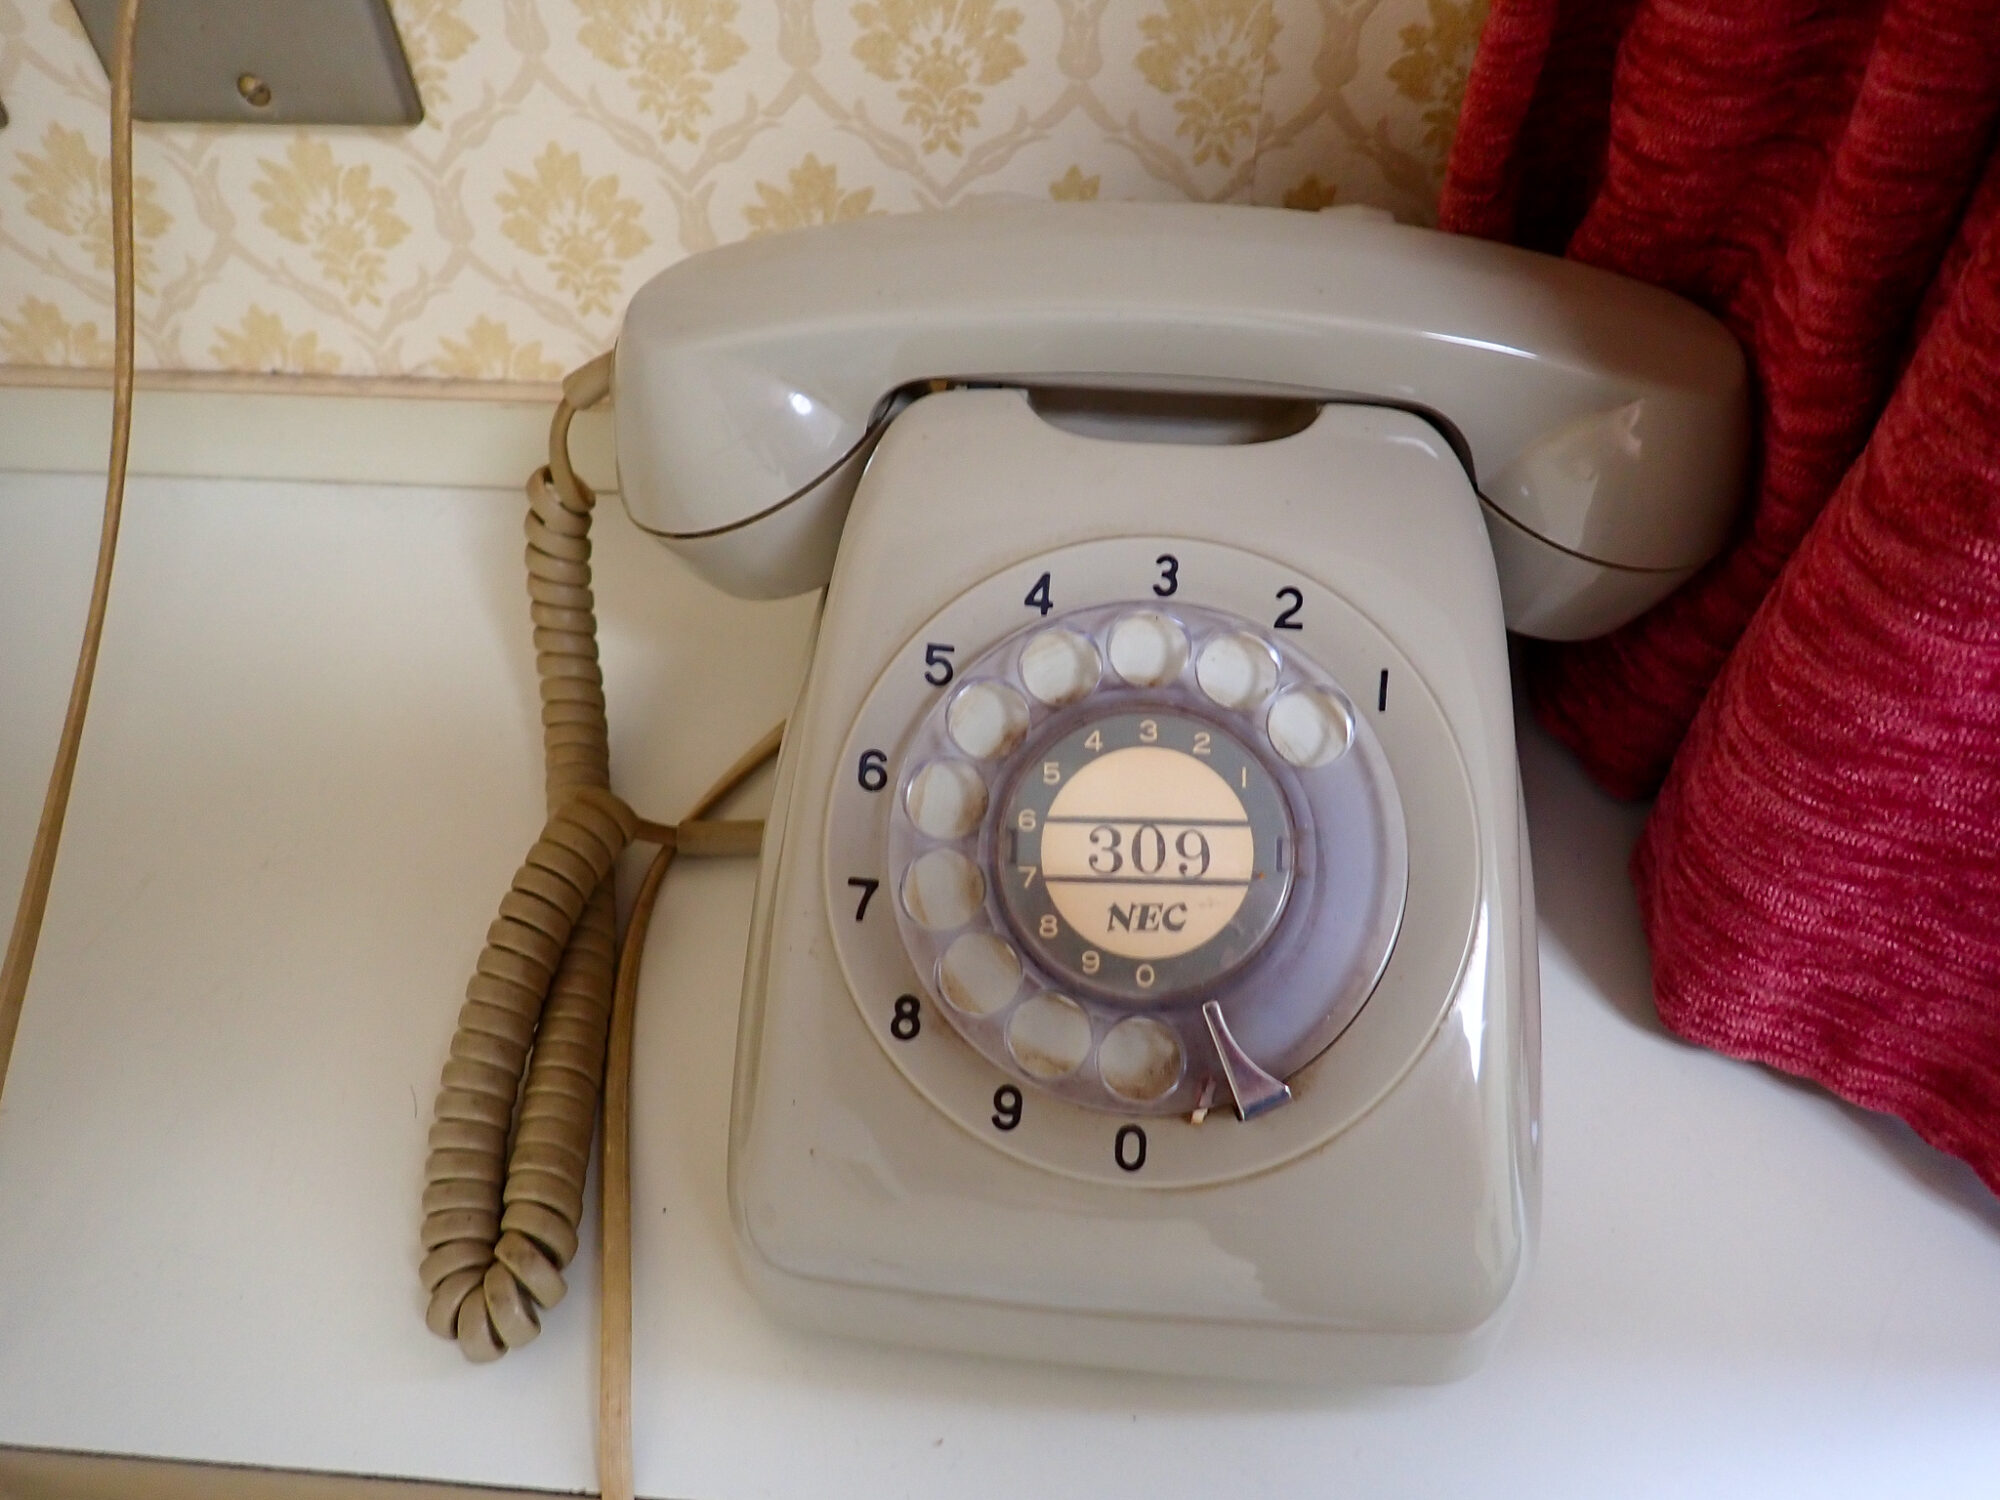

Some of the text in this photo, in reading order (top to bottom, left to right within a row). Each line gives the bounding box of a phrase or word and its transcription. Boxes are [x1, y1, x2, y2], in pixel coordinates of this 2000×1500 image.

[1152, 554, 1179, 597] 3
[1023, 572, 1054, 617] 4
[1273, 586, 1304, 631] 2
[924, 643, 955, 689] 5
[1378, 669, 1389, 713] 1
[1084, 729, 1103, 752] 4
[1139, 719, 1158, 743] 3
[1193, 731, 1211, 754] 2
[857, 748, 888, 793] 6
[1043, 762, 1060, 785] 5
[1241, 766, 1247, 788] 1
[1018, 808, 1036, 830] 6
[1088, 823, 1211, 878] 309
[1018, 866, 1037, 889] 7
[847, 876, 880, 922] 7
[1107, 901, 1188, 933] NEC
[1039, 914, 1058, 938] 8
[1081, 950, 1100, 974] 9
[1136, 963, 1155, 988] 0
[890, 993, 921, 1041] 8
[991, 1083, 1023, 1132] 9
[1114, 1123, 1147, 1172] 0
